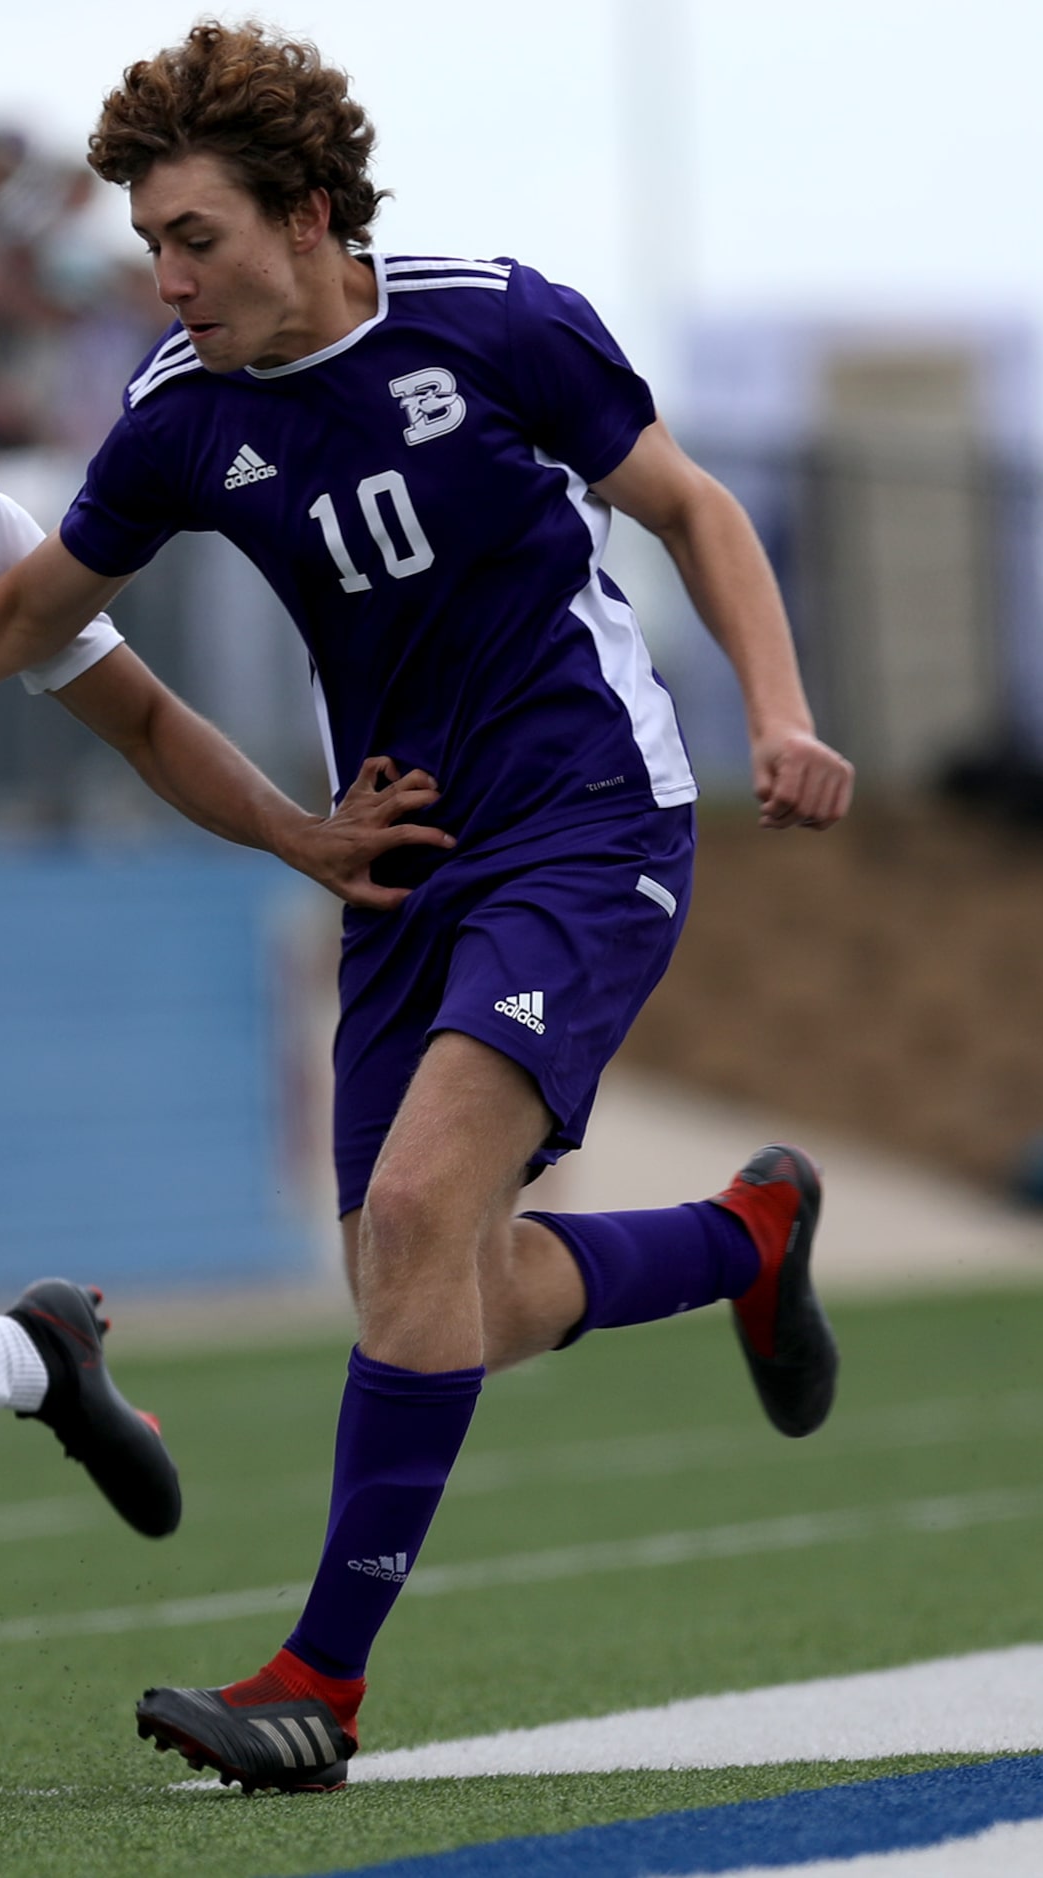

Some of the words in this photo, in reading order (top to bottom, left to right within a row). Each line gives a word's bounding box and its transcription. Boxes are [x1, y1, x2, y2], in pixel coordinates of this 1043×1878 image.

[388, 367, 467, 447] B
[224, 464, 278, 490] adidas
[308, 469, 435, 594] 10
[494, 1000, 546, 1035] adidas
